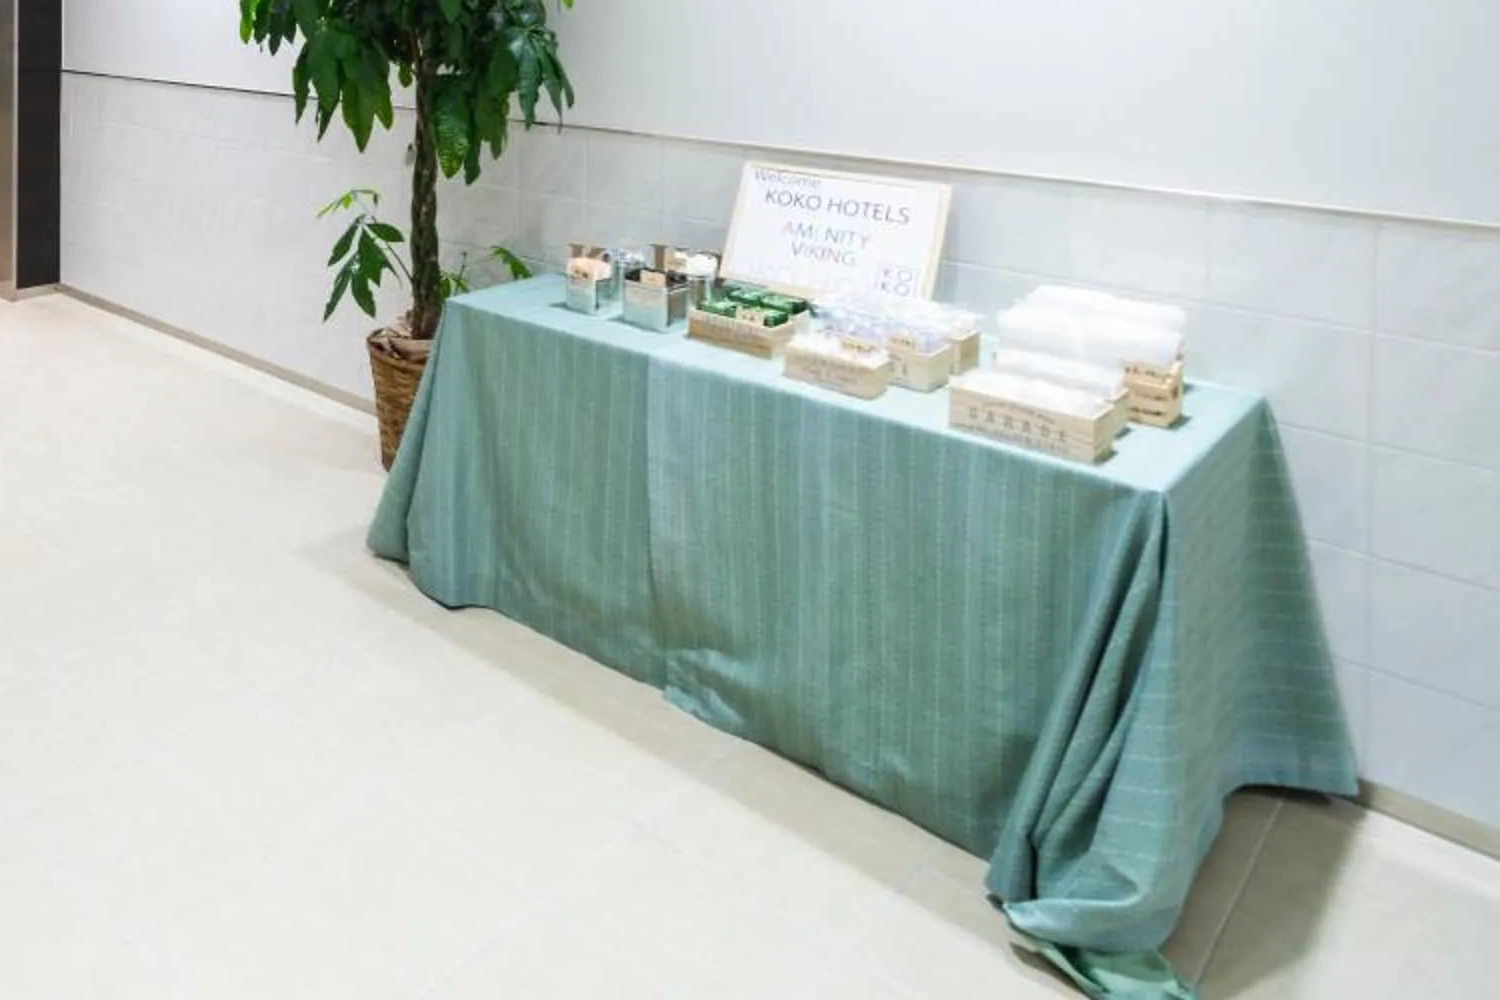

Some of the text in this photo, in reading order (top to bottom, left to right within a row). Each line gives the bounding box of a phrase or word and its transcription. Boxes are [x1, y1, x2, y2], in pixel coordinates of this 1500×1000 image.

[765, 188, 910, 225] KOKO HOTELS
[790, 242, 856, 265] VIKING
